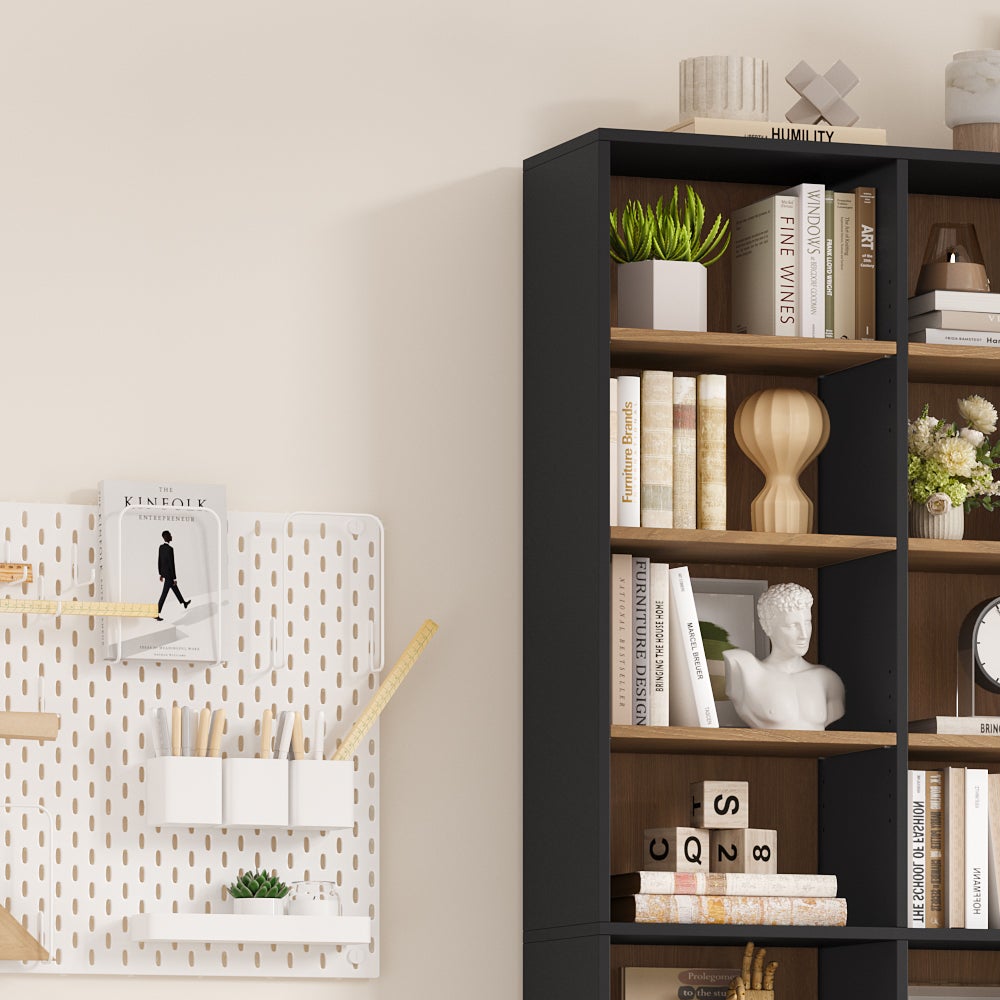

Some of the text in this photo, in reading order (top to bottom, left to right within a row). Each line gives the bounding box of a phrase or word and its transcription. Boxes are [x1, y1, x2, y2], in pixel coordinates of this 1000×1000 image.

[771, 127, 835, 143] HUMILITY
[780, 216, 795, 256] FINE
[807, 189, 821, 255] WINDOWS
[861, 224, 874, 251] ART
[780, 265, 795, 324] WINES
[621, 401, 633, 503] Furniture Brands
[138, 514, 195, 523] ENTREPRENEUR
[635, 560, 647, 726] FURNITURE DESIGN
[655, 600, 664, 692] BRINGING THE HOUSE HOME
[687, 622, 704, 680] MARCEL BREUER
[713, 794, 740, 816] S
[684, 836, 701, 865] Q
[718, 843, 737, 862] 2
[752, 844, 771, 862] 8
[688, 972, 735, 982] Prolegome
[683, 988, 727, 997] to the stu
